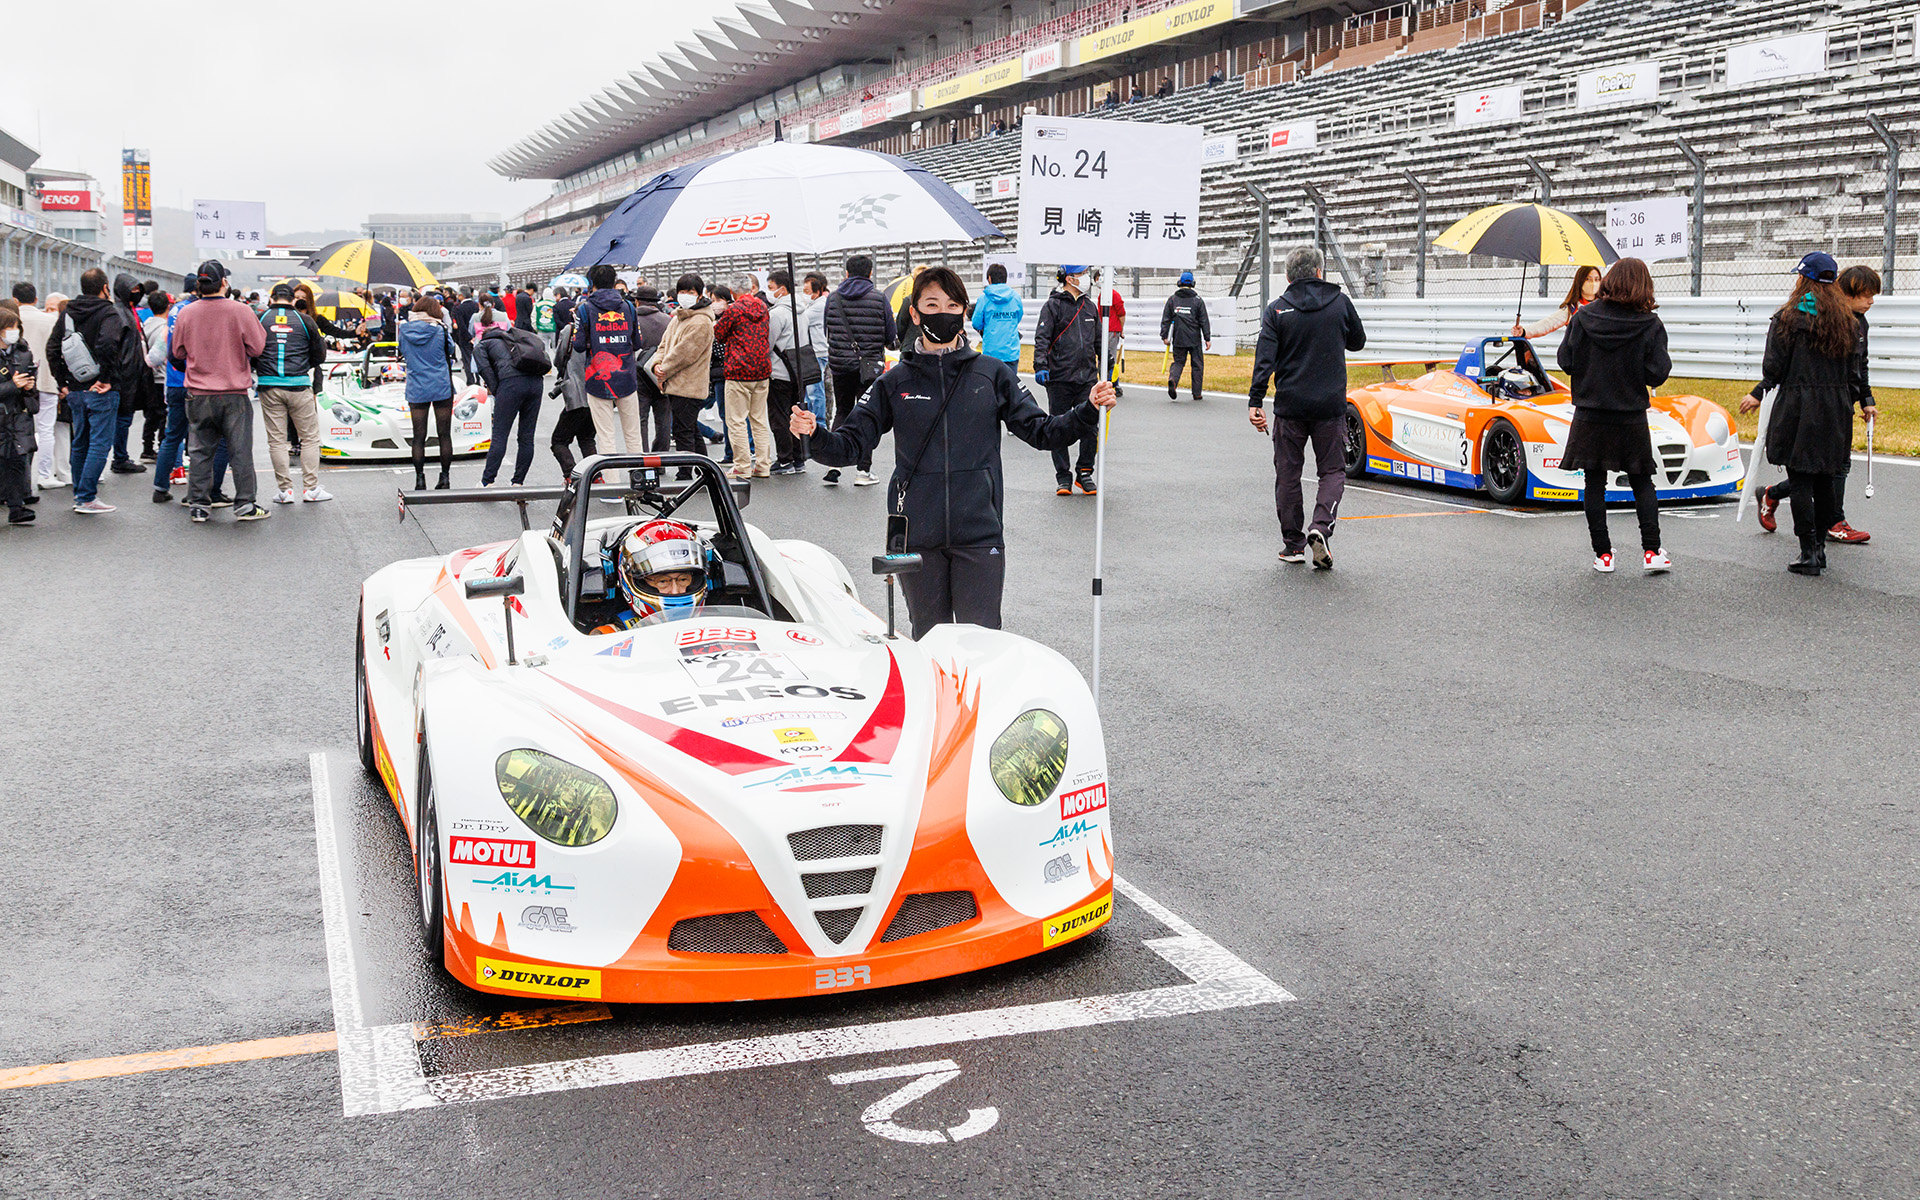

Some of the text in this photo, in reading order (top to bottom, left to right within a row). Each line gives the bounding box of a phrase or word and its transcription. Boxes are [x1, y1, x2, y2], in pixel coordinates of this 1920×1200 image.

[1173, 4, 1215, 27] DUNLOP
[1099, 30, 1135, 50] DUNLOP
[984, 68, 1011, 84] DUNLOP
[1597, 72, 1636, 94] KeePer
[938, 84, 960, 99] DUNLOP
[863, 107, 886, 122] NISSAN
[1031, 149, 1108, 179] No. 24
[40, 195, 80, 205] ENSO
[196, 211, 220, 220] No. 4
[697, 213, 771, 237] BBS
[1040, 207, 1187, 240] 見崎 清志
[1611, 212, 1645, 227] No. 36
[201, 229, 260, 241] 片山 右京
[1616, 232, 1682, 249] 福山 英朗
[596, 322, 629, 332] Red Bull
[1412, 423, 1457, 442] KOYASU
[674, 626, 757, 646] BBS
[706, 658, 785, 684] 24
[659, 684, 867, 716] ENEOS
[1073, 778, 1086, 786] Dr.
[1087, 772, 1103, 782] Dry
[1063, 786, 1106, 817] MOTUL
[453, 823, 509, 833] Dr. Dry
[453, 840, 532, 865] MOTUL
[521, 905, 573, 933] CAE
[1060, 901, 1110, 934] DUNLOP
[499, 969, 590, 989] DUNLOP
[829, 1058, 999, 1146] 2
